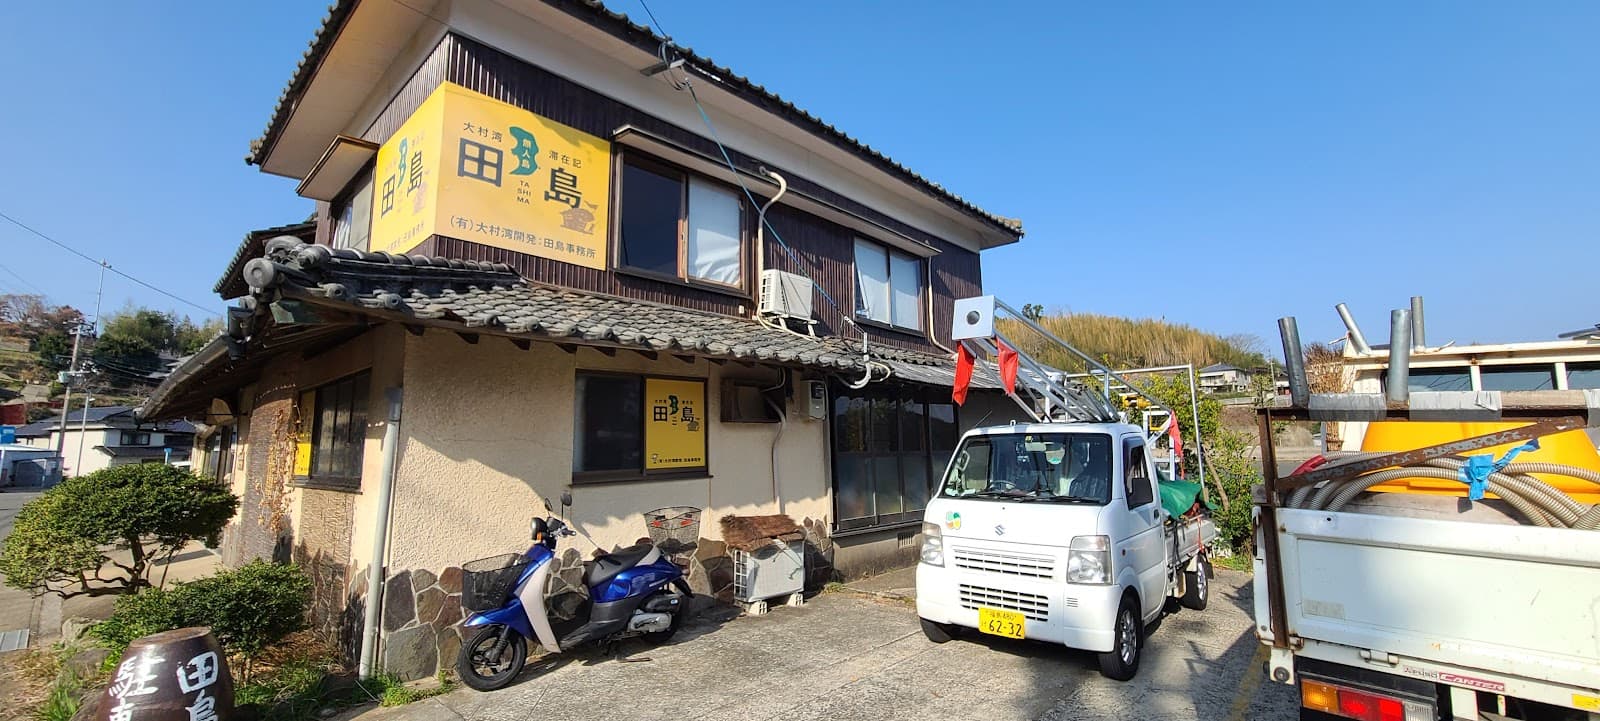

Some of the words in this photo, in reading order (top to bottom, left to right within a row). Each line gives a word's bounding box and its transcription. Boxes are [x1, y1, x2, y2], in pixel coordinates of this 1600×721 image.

[463, 121, 502, 142] 大村湾
[549, 151, 582, 168] 滞在記
[457, 137, 504, 187] 田
[544, 167, 582, 209] 島
[381, 174, 396, 219] 田
[407, 150, 423, 197] 島
[517, 187, 532, 197] SHI
[519, 180, 530, 188] TA
[517, 196, 530, 205] MA
[654, 407, 667, 421] 田
[989, 619, 1022, 637] 62-32
